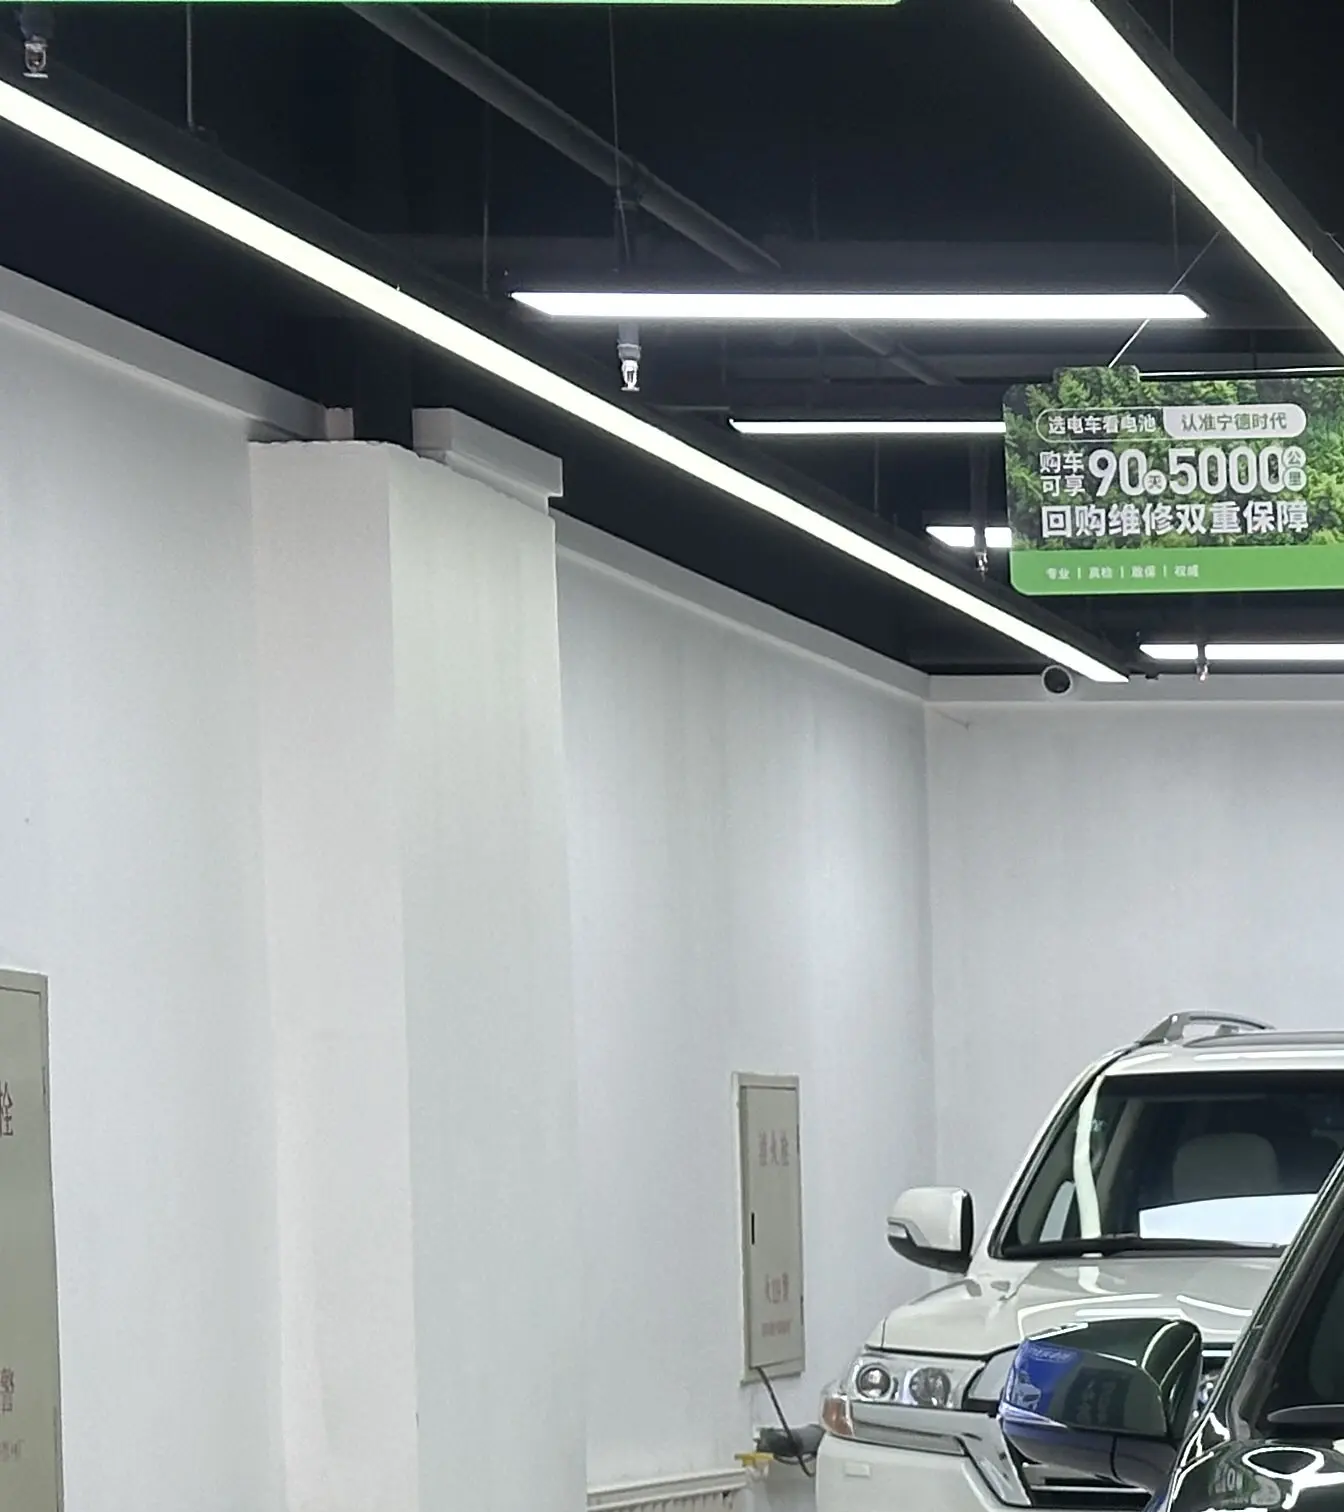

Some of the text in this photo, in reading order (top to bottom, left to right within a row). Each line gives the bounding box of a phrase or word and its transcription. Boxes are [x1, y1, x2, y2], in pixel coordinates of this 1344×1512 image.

[1048, 414, 1156, 435] 选电车看电池
[1181, 412, 1287, 432] 认准宁德时代
[1039, 450, 1084, 473] 购车
[1041, 474, 1086, 497] 可享
[1041, 500, 1309, 538] 回购维修双重保障
